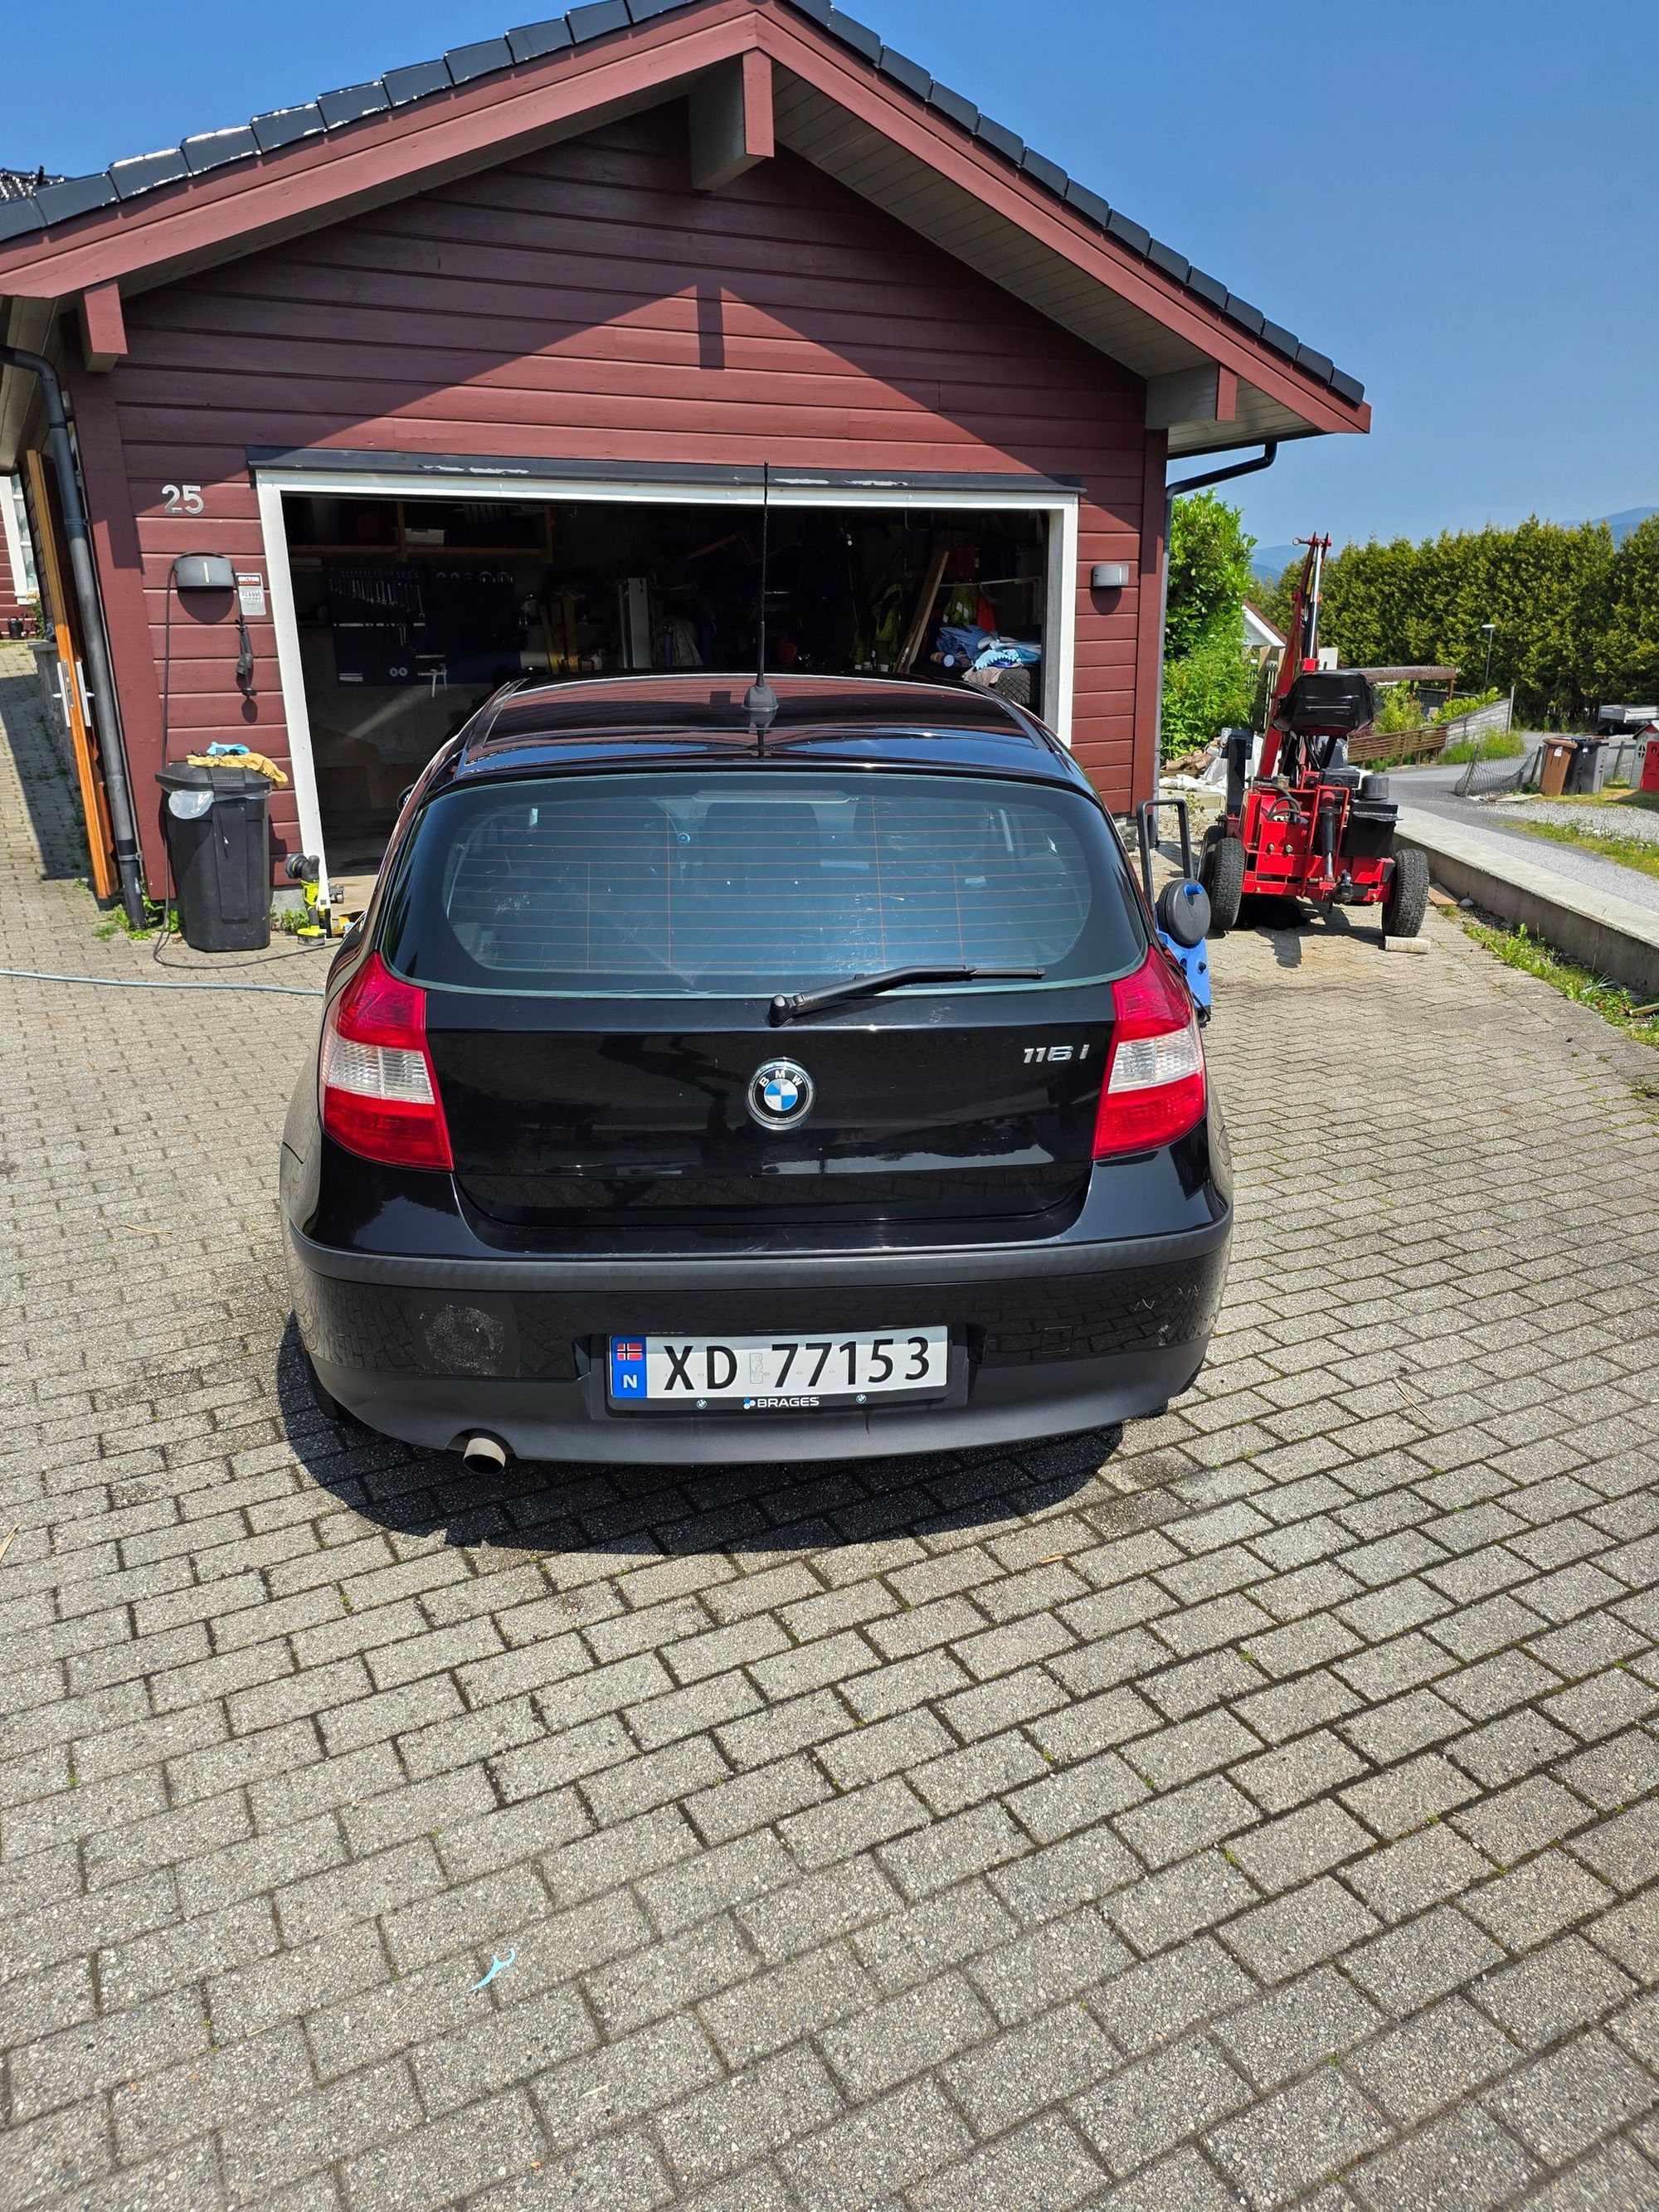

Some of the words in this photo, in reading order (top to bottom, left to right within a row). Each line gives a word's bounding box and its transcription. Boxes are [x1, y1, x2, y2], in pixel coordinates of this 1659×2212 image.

[162, 484, 204, 514] 25
[758, 1070, 803, 1087] BMW
[664, 1345, 737, 1390] XD
[771, 1336, 930, 1388] 77153
[623, 1374, 637, 1388] N
[757, 1397, 818, 1407] BRAGES
